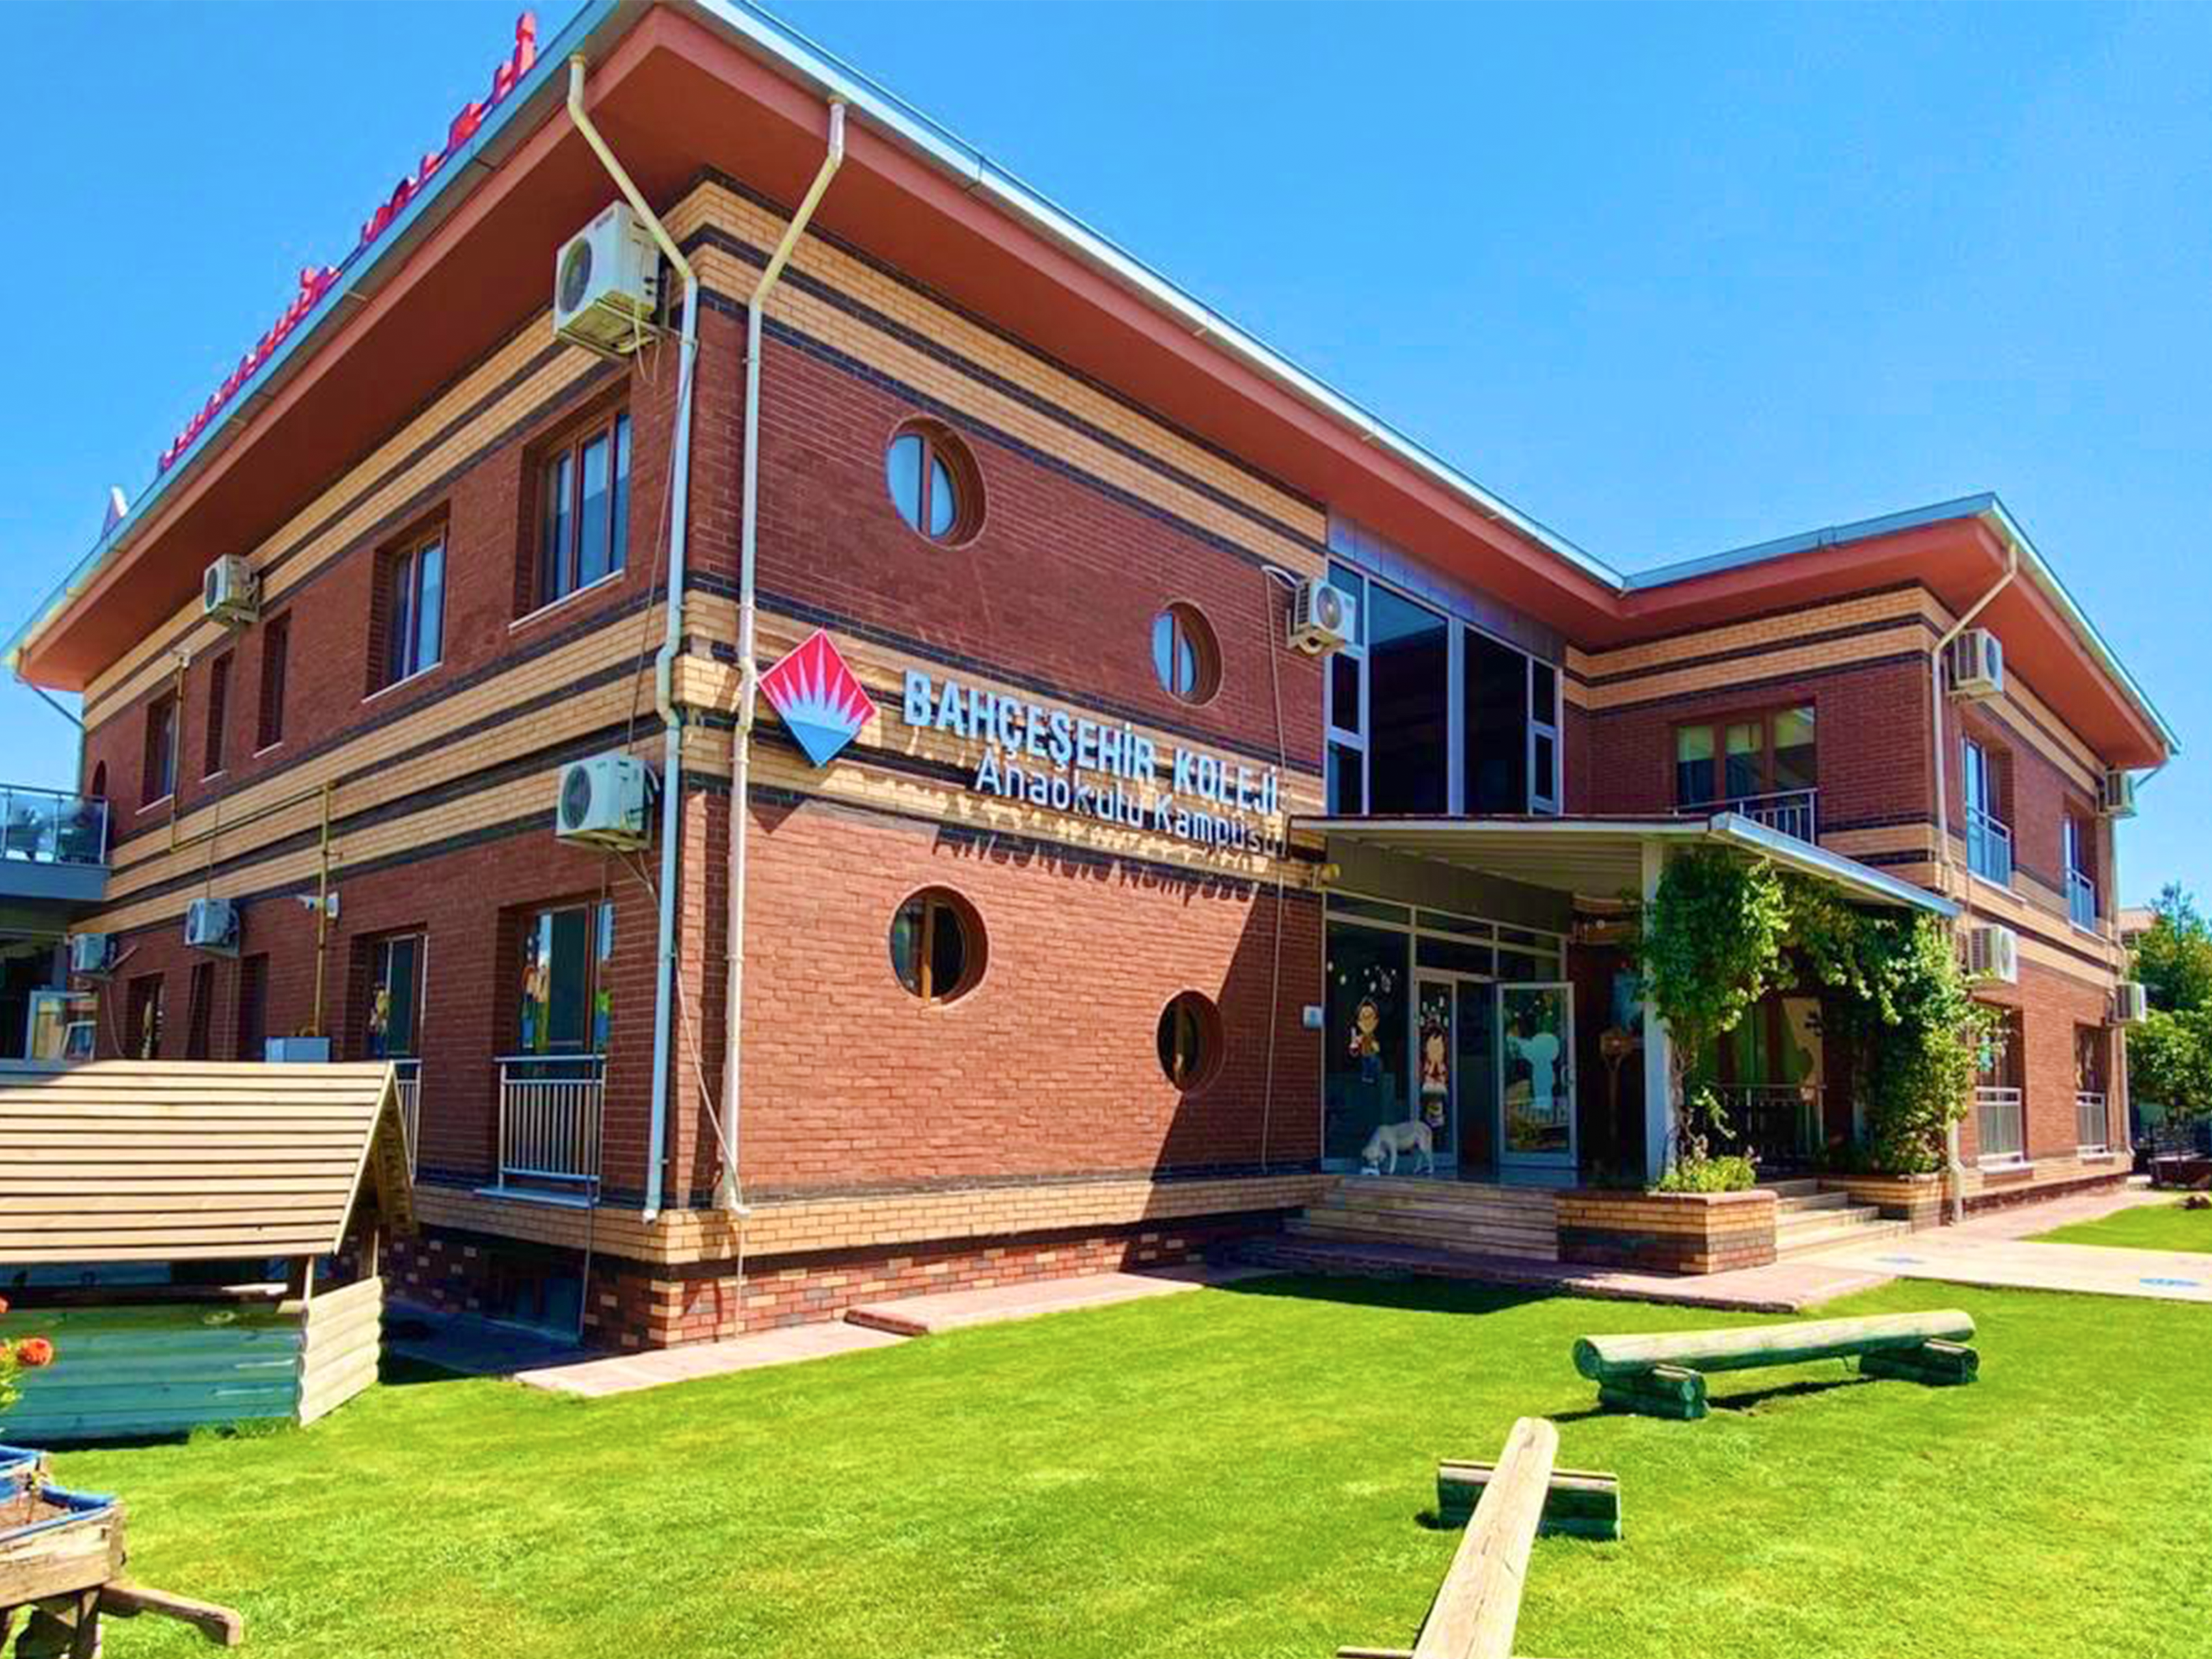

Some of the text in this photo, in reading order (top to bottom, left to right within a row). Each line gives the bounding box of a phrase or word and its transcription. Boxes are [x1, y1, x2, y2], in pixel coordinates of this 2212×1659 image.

[904, 669, 1277, 816] BAHÇEŞEHİR KOLEJİ
[974, 747, 1144, 828] Anaokulu
